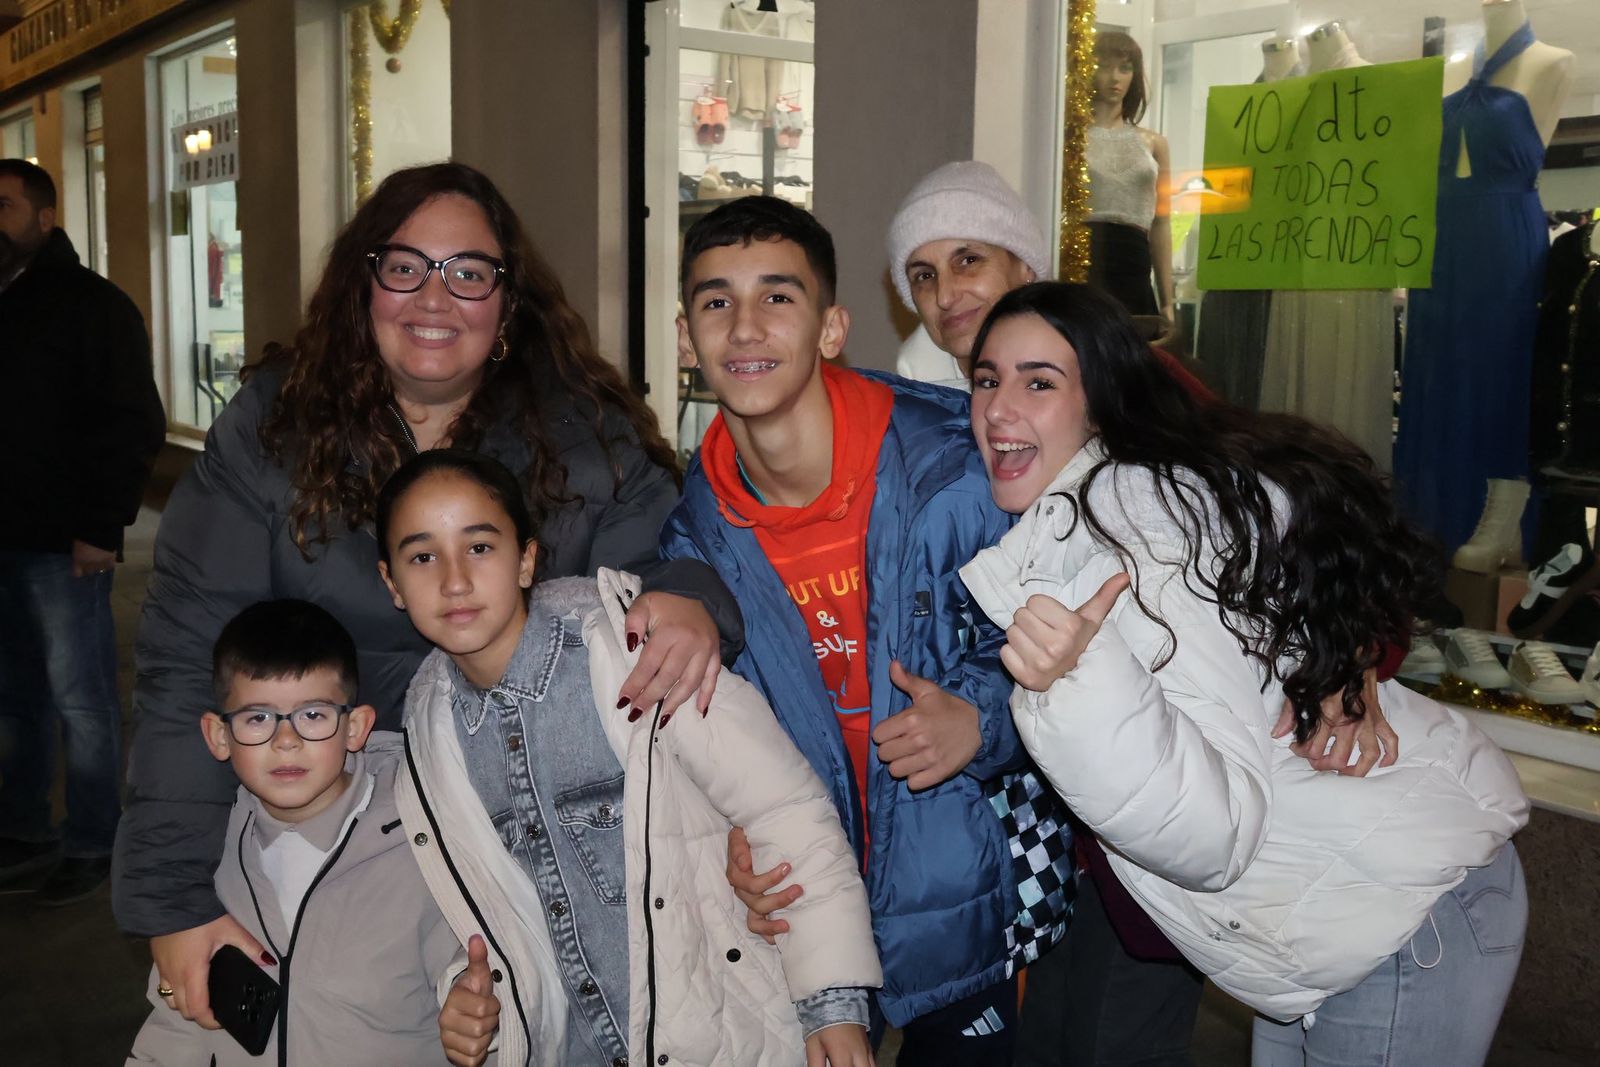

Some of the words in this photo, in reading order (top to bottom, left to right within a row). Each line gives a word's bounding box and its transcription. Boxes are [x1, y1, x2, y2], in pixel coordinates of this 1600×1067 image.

[1316, 75, 1392, 142] dto
[1273, 158, 1379, 207] TODAS
[1206, 221, 1262, 262] LAS
[1270, 214, 1423, 268] PRENDAS
[785, 577, 822, 605] UT
[816, 610, 839, 627] &
